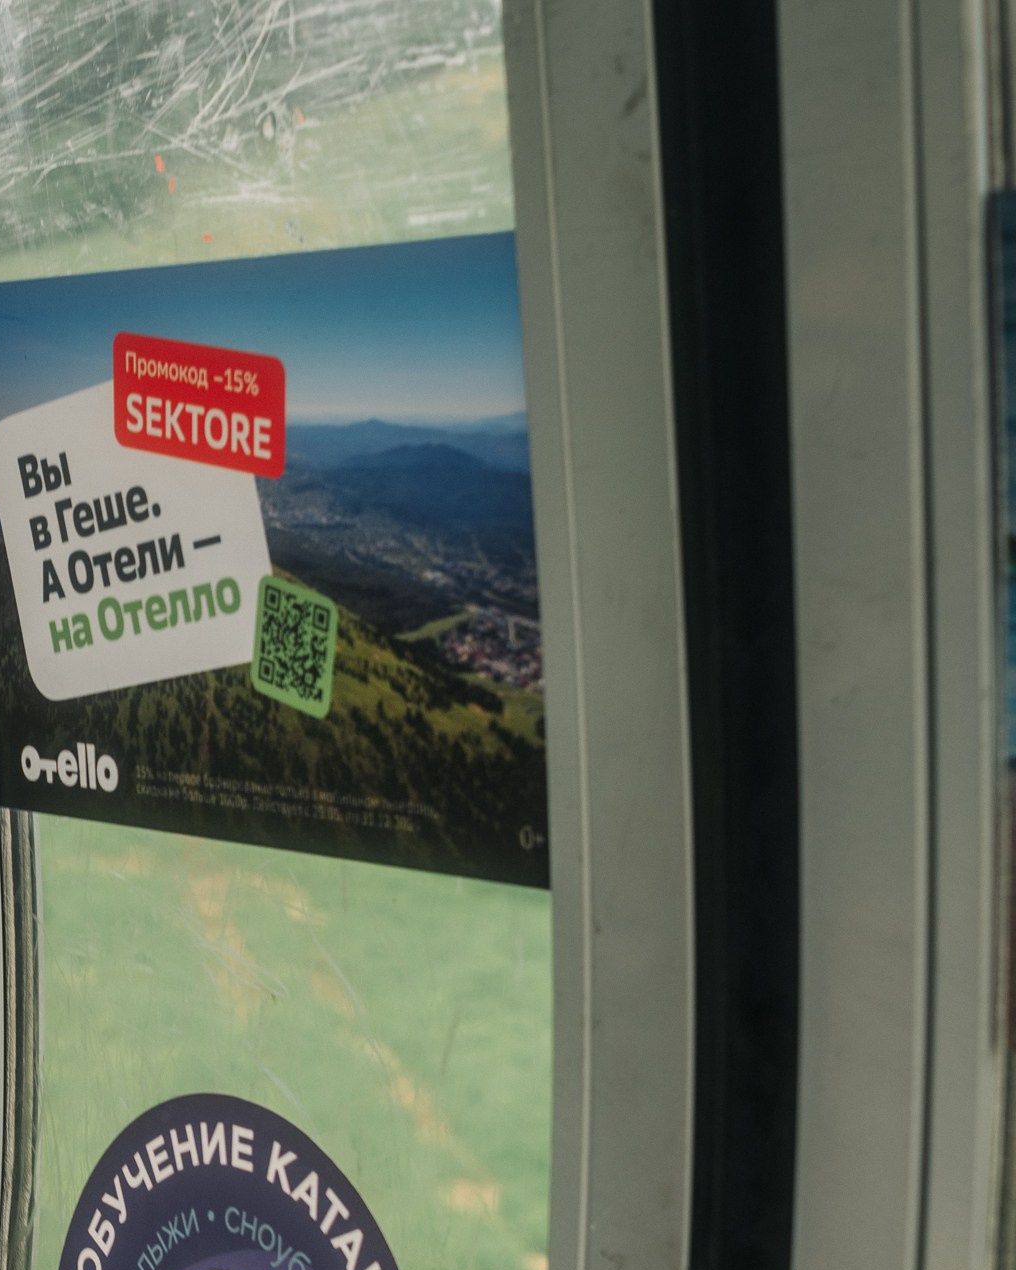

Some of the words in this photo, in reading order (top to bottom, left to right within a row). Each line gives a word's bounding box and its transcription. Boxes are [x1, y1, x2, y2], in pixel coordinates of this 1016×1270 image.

[125, 351, 209, 388] Промокод
[126, 393, 272, 459] SEKTORE
[17, 452, 72, 499] Вы
[29, 515, 52, 551] в
[55, 485, 161, 543] Геше.
[42, 559, 66, 603] А
[67, 533, 186, 595] Отели
[49, 612, 94, 654] на
[97, 577, 241, 641] Отелло
